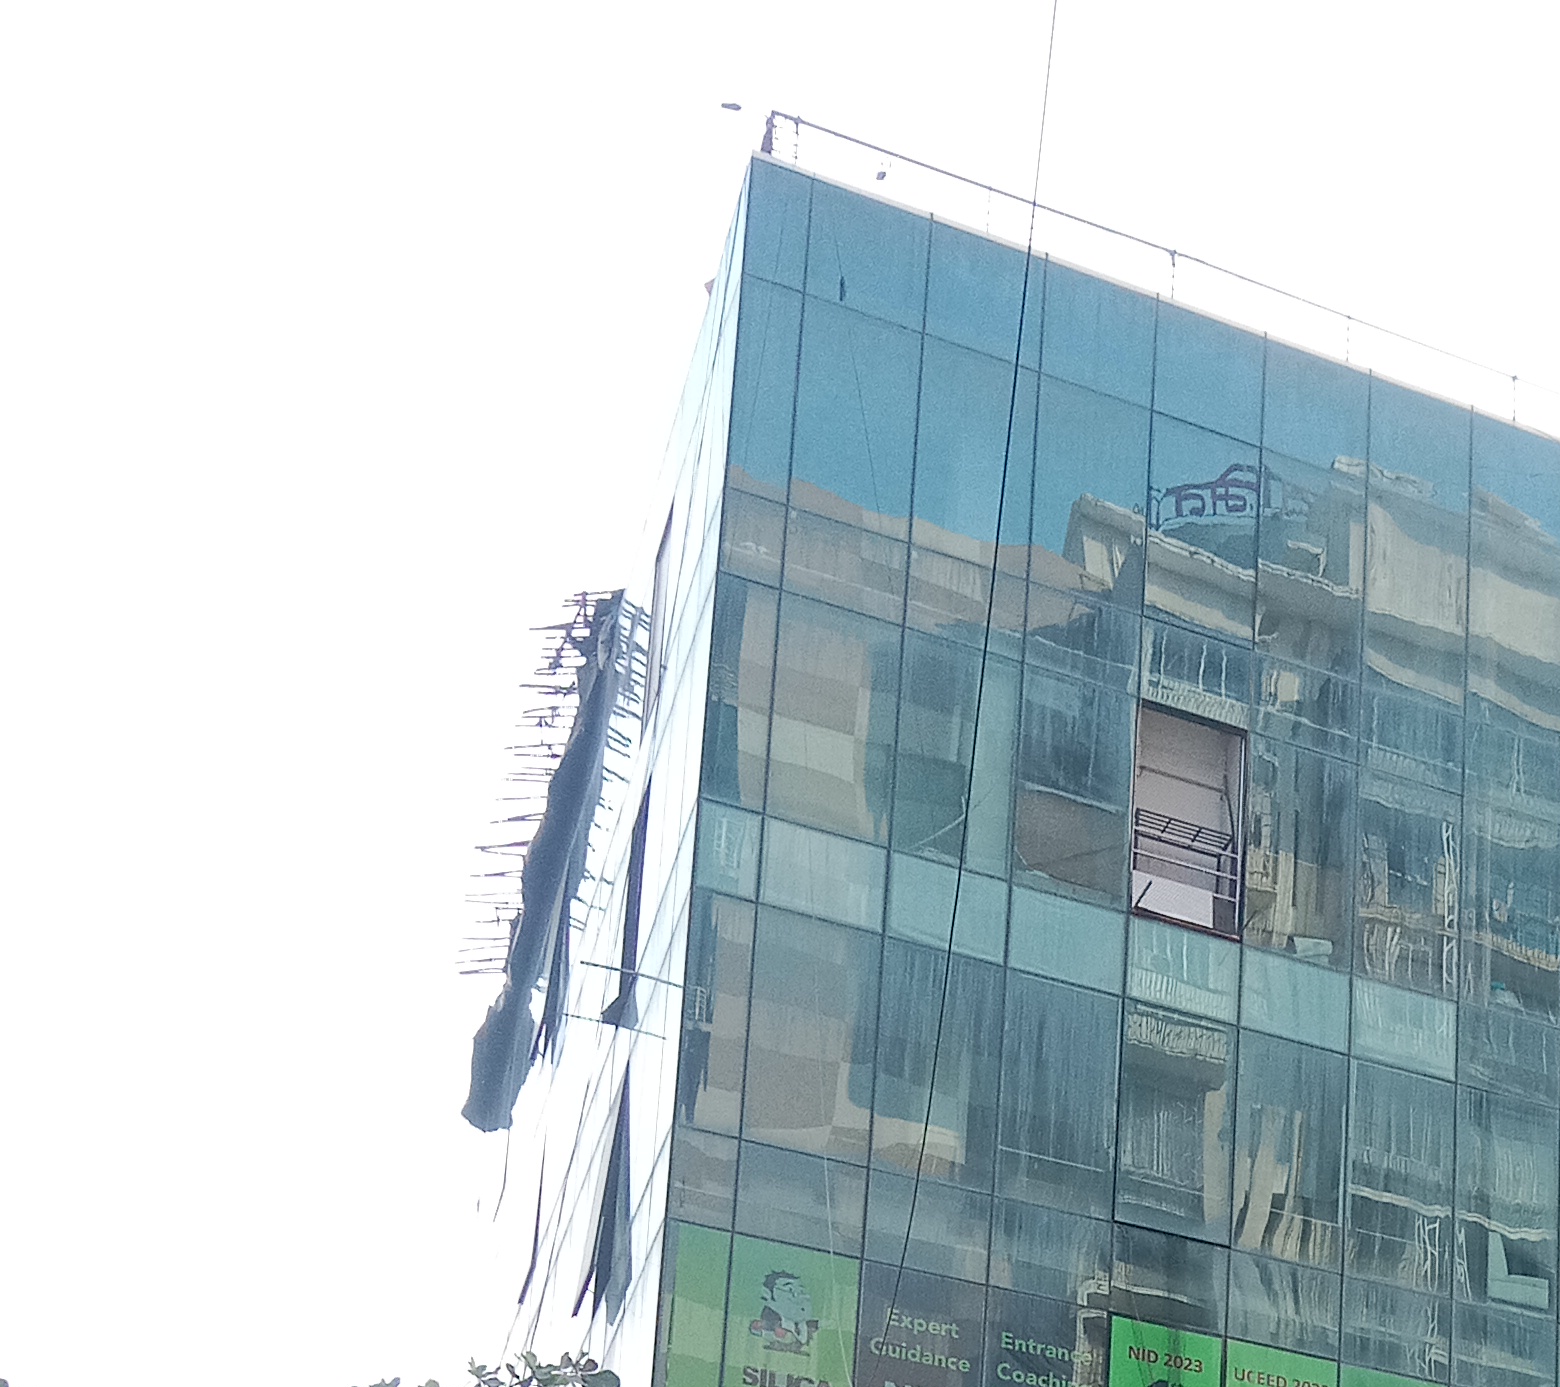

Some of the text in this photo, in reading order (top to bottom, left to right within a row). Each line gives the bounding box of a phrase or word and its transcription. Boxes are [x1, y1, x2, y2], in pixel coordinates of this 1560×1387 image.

[886, 1306, 959, 1339] Expert
[870, 1338, 971, 1373] Guidance
[1000, 1332, 1093, 1366] Entrance
[1128, 1346, 1203, 1373] NID 2023
